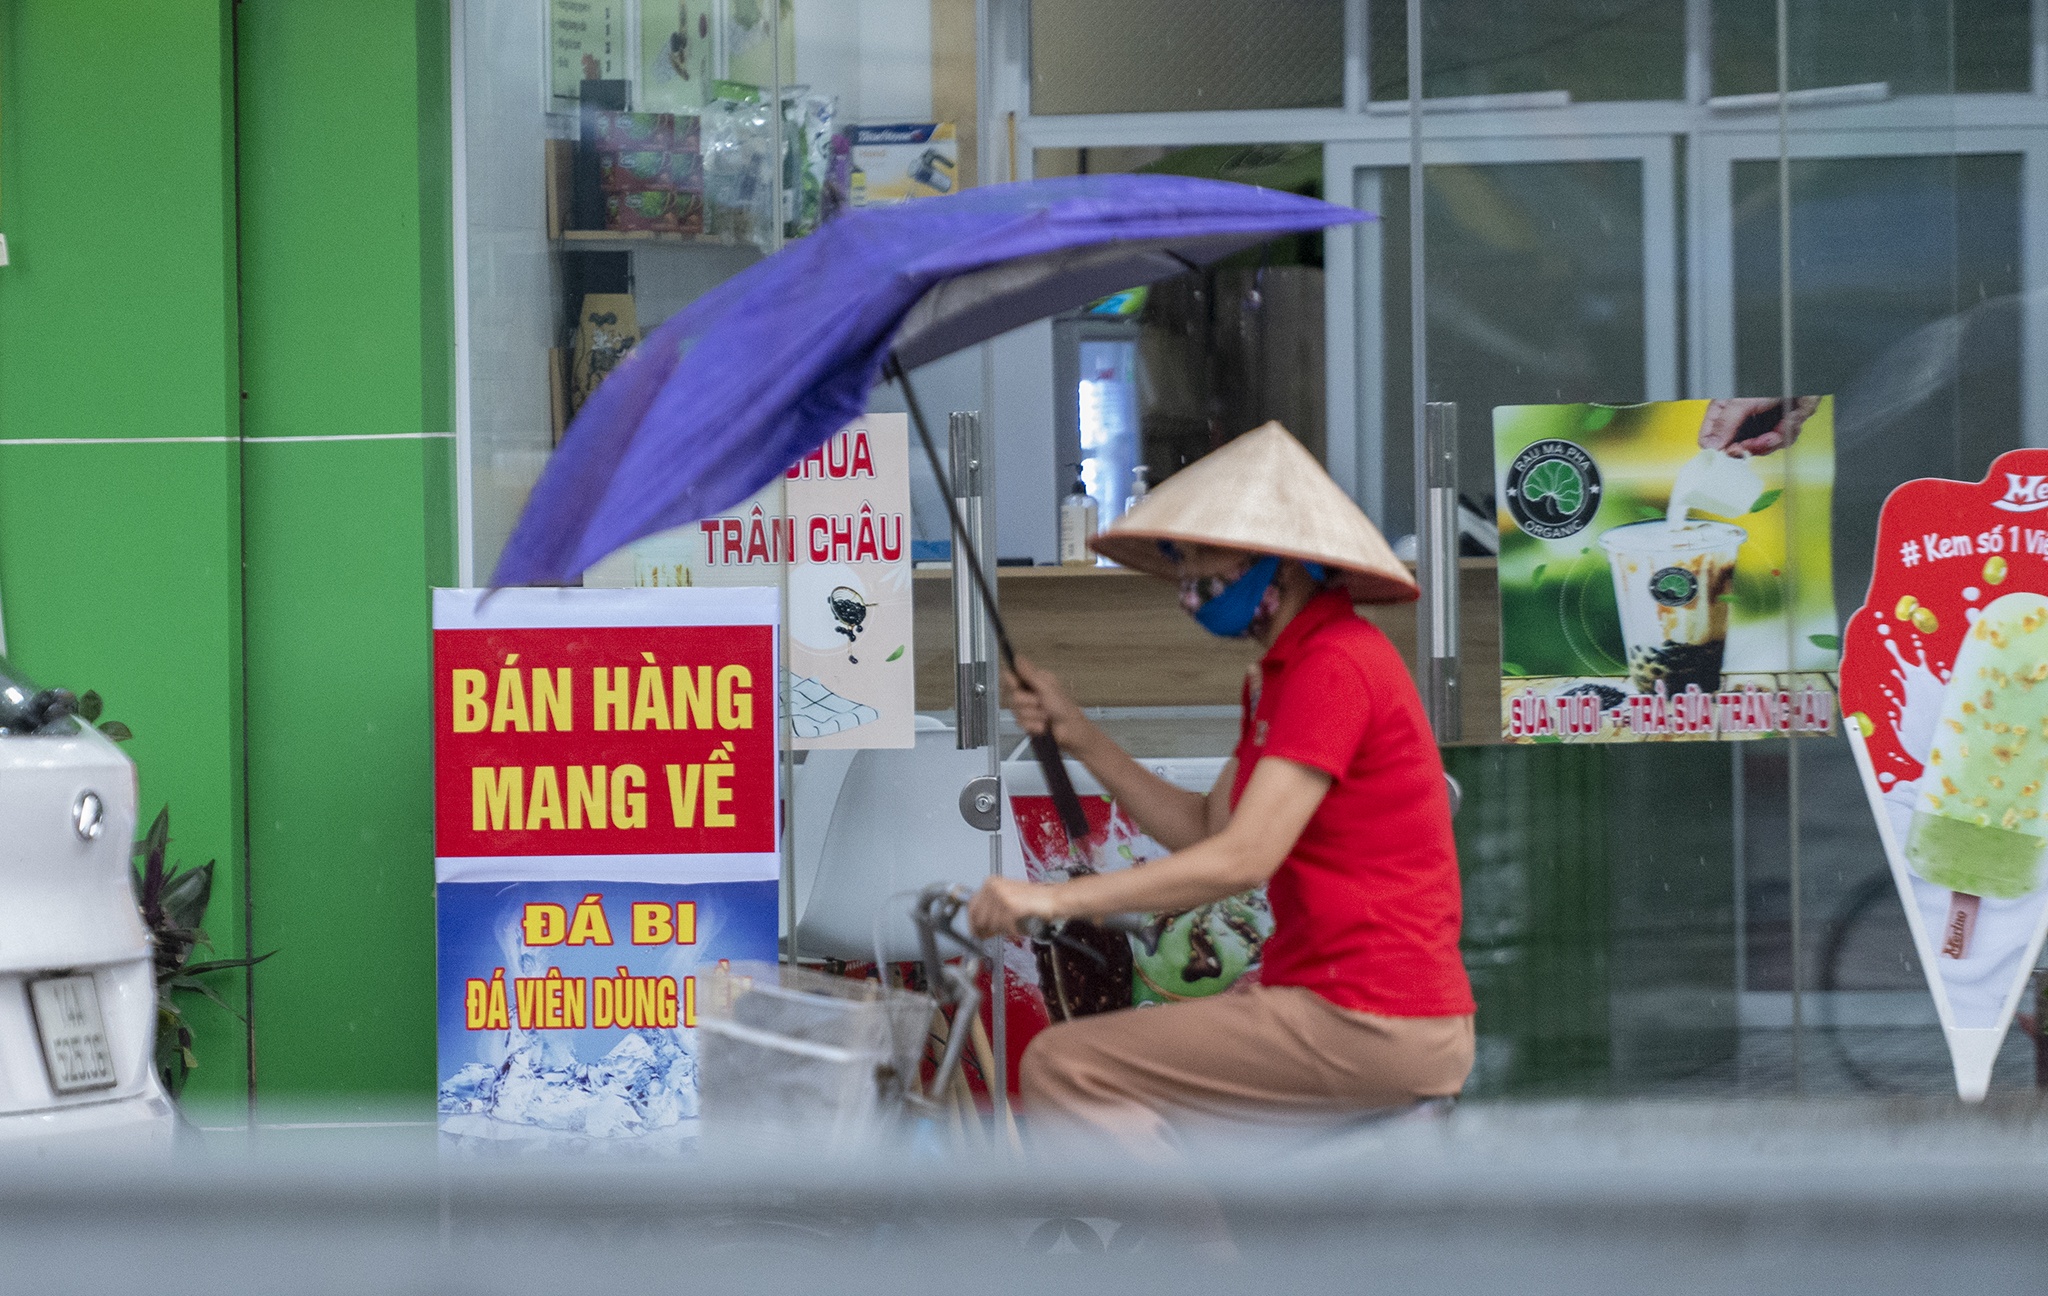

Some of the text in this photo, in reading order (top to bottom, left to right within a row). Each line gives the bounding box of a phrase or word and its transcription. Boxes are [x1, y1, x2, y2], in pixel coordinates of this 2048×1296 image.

[785, 431, 876, 480] HUA
[1514, 447, 1540, 472] RAU
[1566, 447, 1590, 471] PHA
[700, 501, 902, 565] TRÂN CHÂU
[1524, 519, 1584, 538] ORGANIC
[1976, 524, 2005, 554] số
[2007, 525, 2020, 553] 1
[452, 652, 753, 733] BÁN HÀNG
[471, 741, 736, 831] MANG VỀ
[522, 893, 697, 947] ĐÁ BI
[465, 967, 511, 1031] ĐÁ
[514, 966, 587, 1030] VIÊN
[593, 965, 679, 1029] DÙNG
